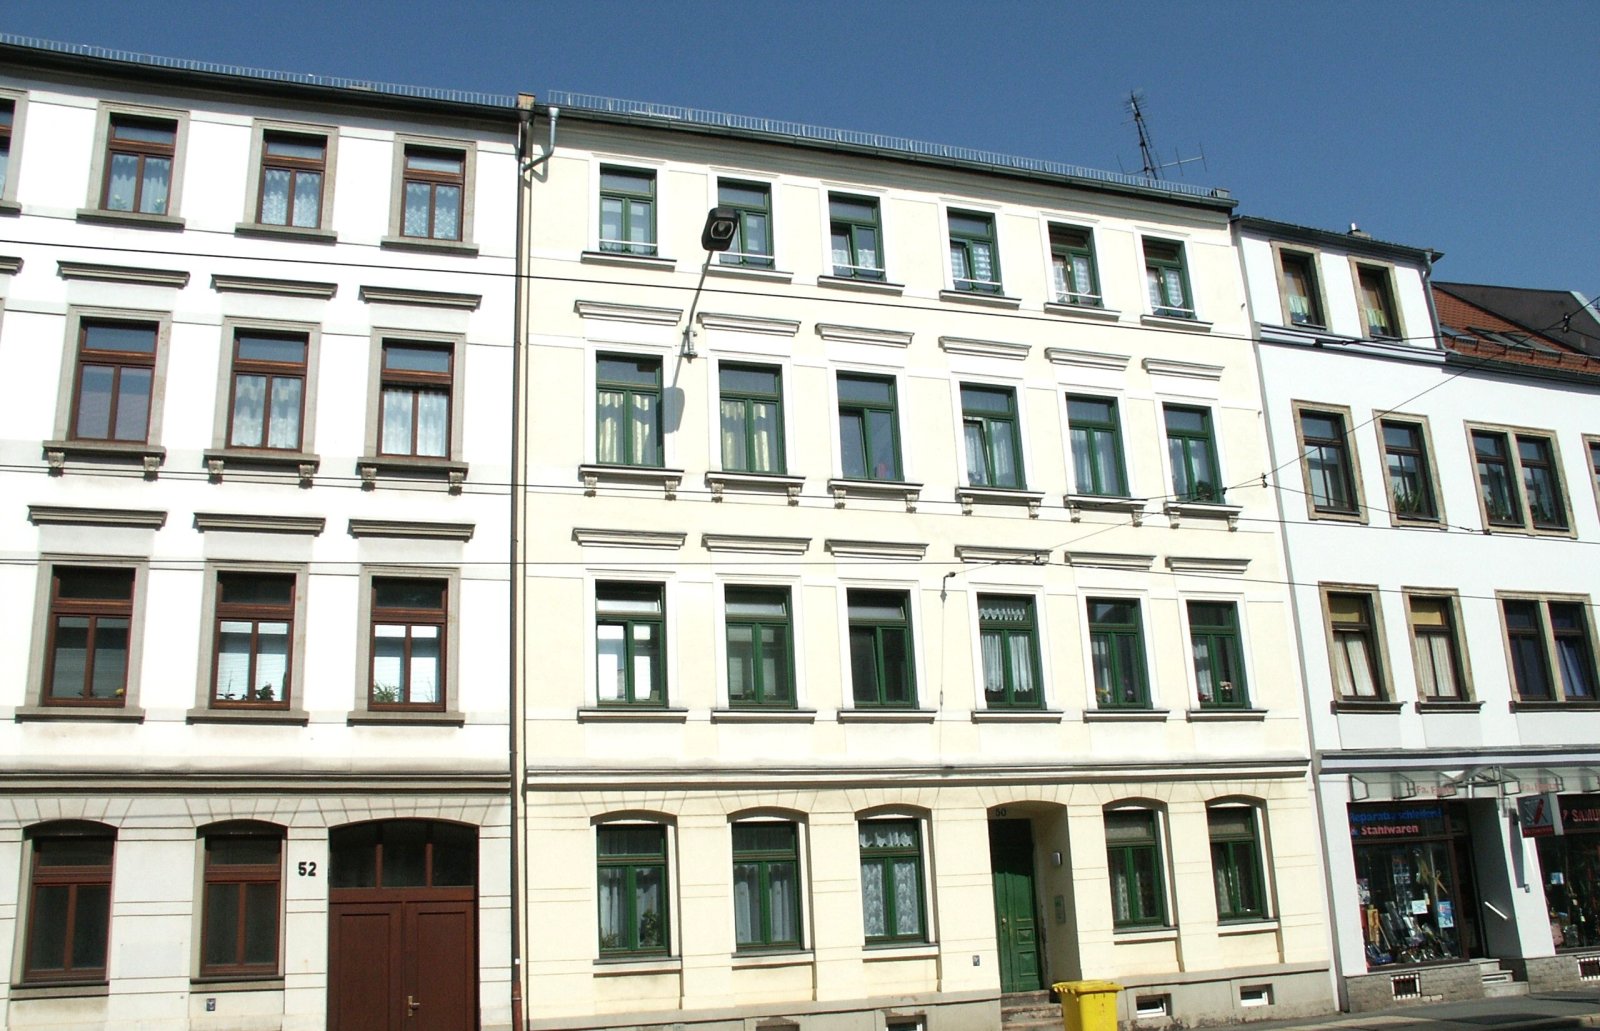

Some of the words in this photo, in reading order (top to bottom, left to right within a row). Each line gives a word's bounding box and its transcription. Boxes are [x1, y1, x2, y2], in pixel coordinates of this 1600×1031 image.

[995, 808, 1007, 817] 50
[1361, 824, 1419, 835] Stahlwaren
[298, 861, 317, 876] 52
